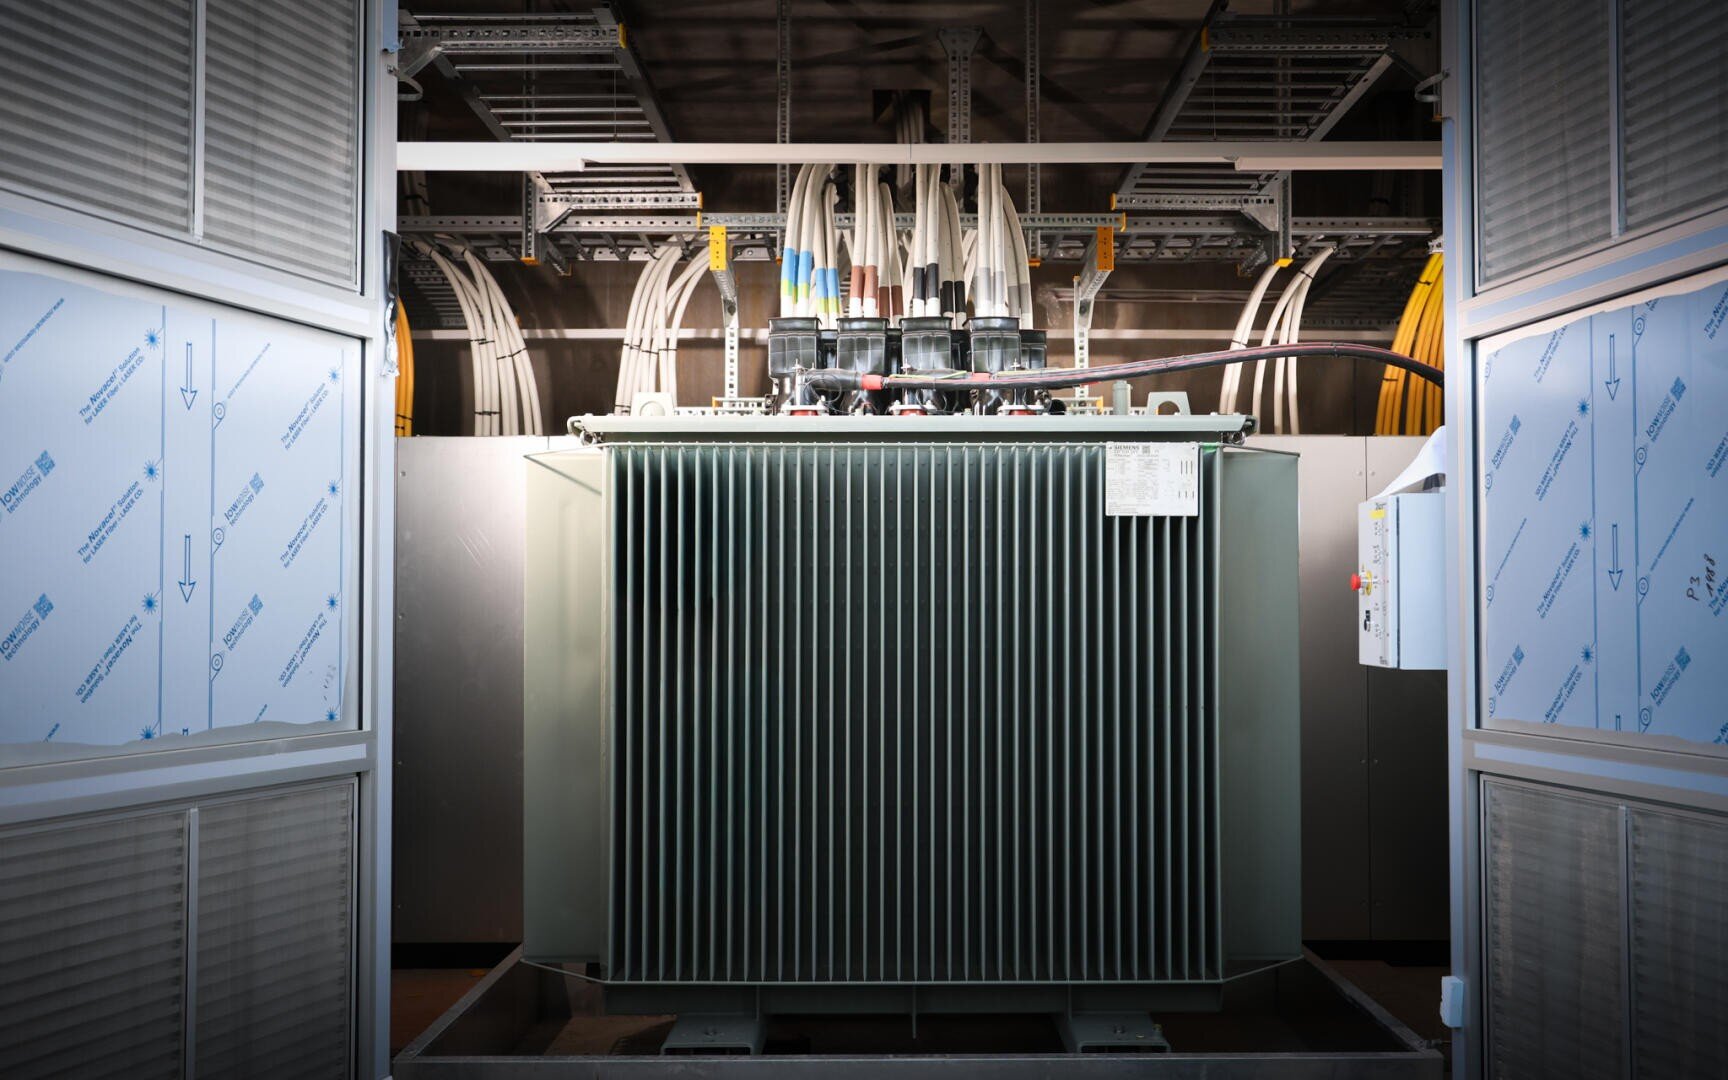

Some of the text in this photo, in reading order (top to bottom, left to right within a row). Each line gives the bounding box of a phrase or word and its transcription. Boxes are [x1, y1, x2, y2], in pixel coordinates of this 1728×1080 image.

[6, 474, 42, 514] technology
[77, 543, 90, 555] The
[116, 481, 139, 507] Solution
[83, 553, 92, 563] for
[89, 534, 106, 554] LASER
[105, 520, 118, 535] Fiber
[119, 498, 135, 517] LASER
